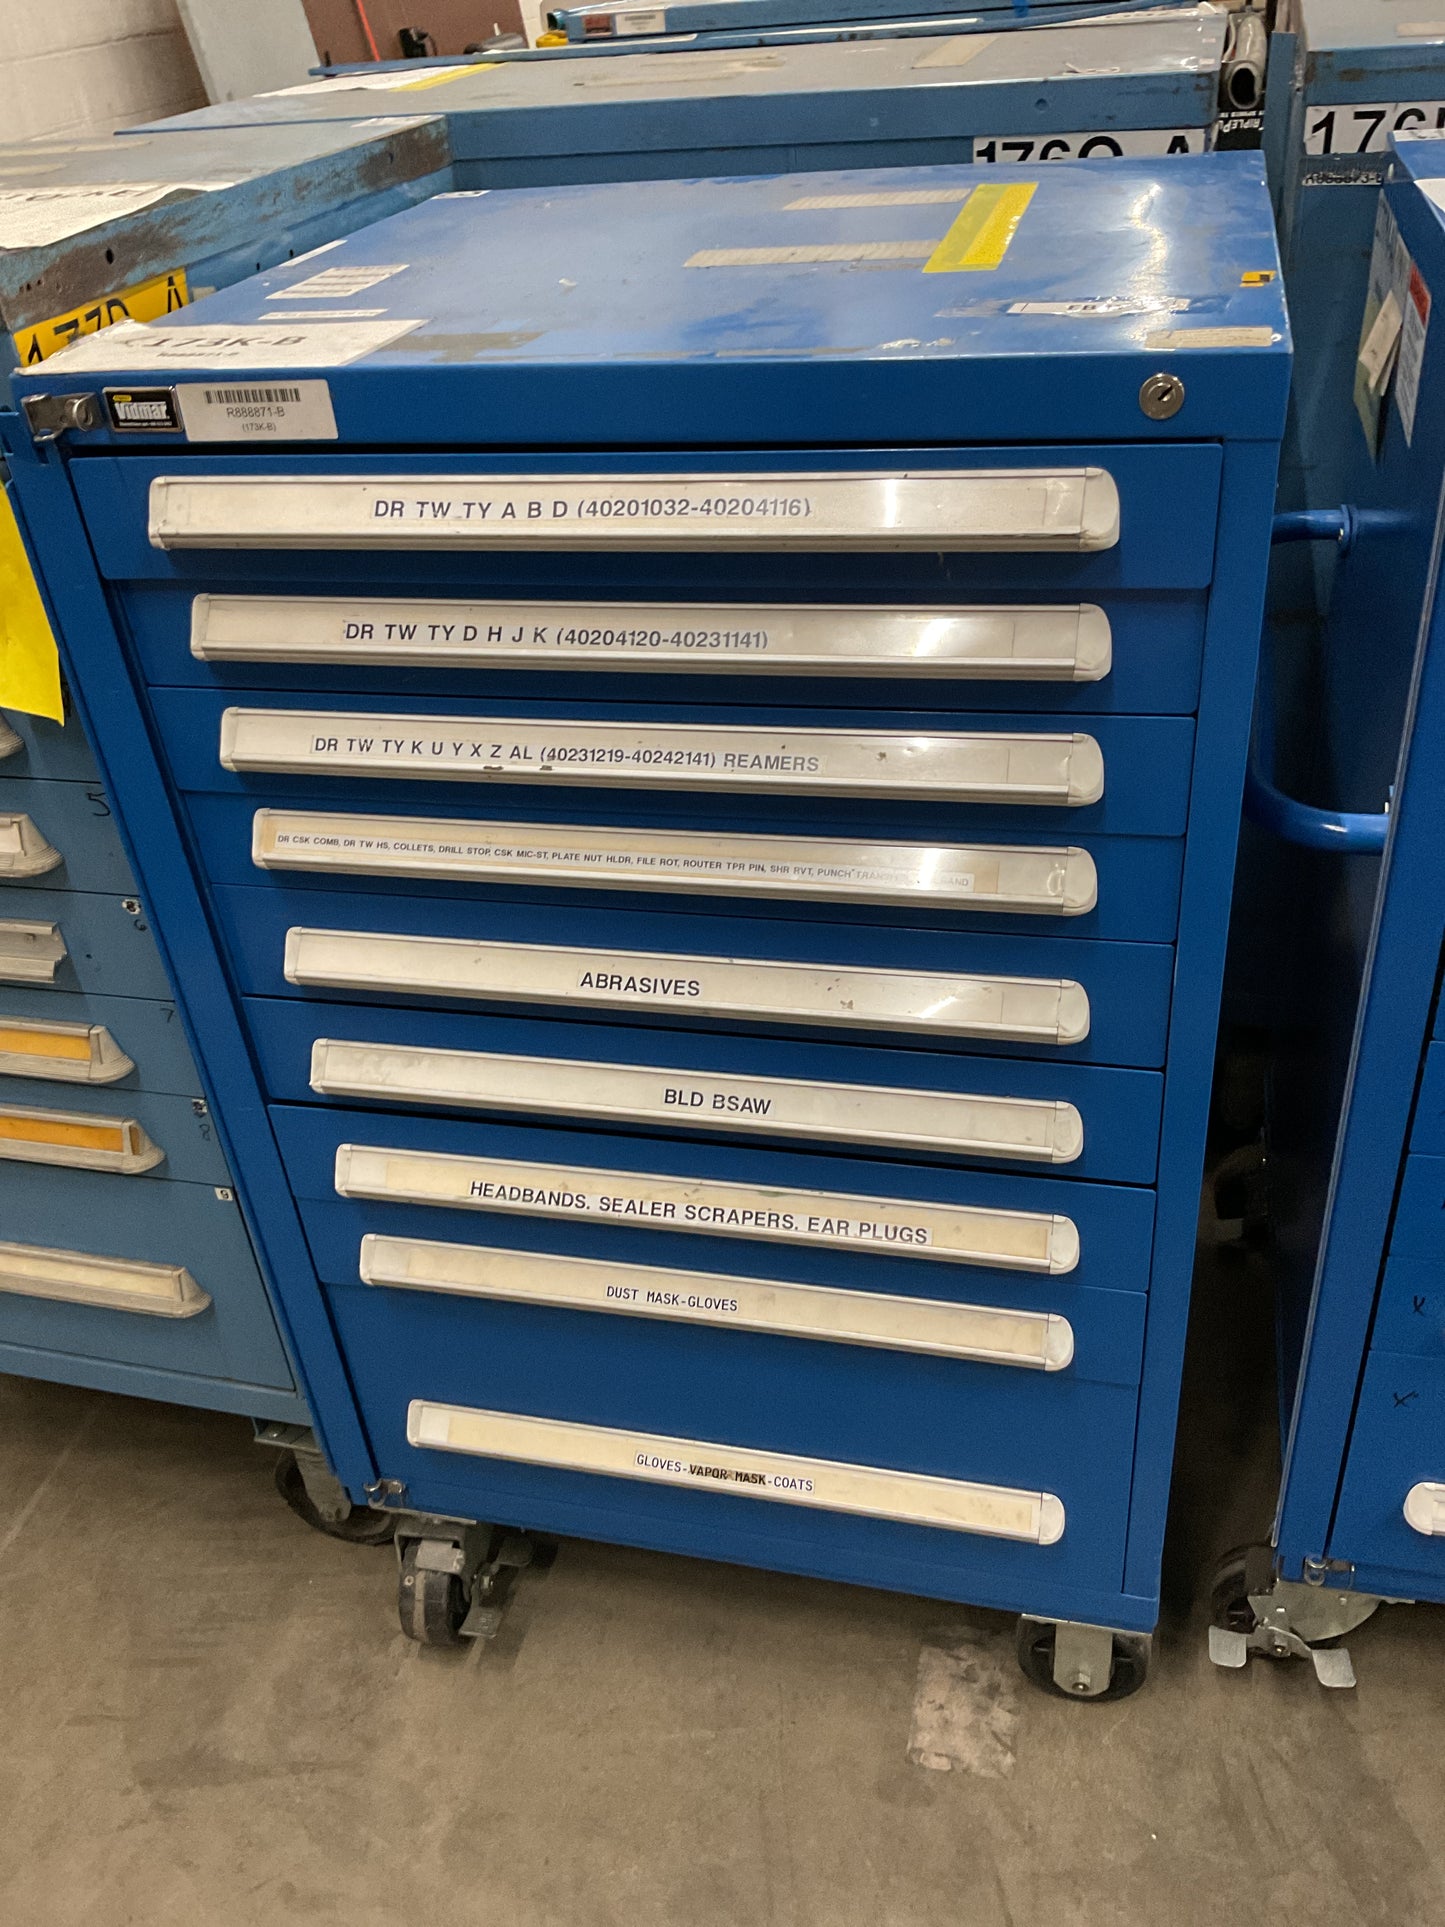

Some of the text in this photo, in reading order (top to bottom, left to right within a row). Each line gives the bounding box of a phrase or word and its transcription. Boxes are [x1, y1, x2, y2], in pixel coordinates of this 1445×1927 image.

[1311, 107, 1445, 154] 176
[114, 401, 168, 420] Vidmar
[226, 406, 285, 418] R888871-B
[242, 423, 277, 433] (173K-B)
[374, 498, 811, 519] DR TW TY A B D (40201032-40204116)
[346, 623, 768, 649] DR TW TY D H J K (40204120-40231141)
[315, 737, 820, 772] DR TW TY K U Y X Z AL (40231219-40242141) REAMERS
[277, 835, 289, 843] DR
[292, 836, 310, 845] CSK
[313, 837, 341, 847] COMB,
[343, 839, 356, 847] DR
[360, 840, 374, 848] TW
[376, 841, 391, 851] HS,
[393, 842, 436, 854] COLLETS,
[438, 845, 463, 854] DRILL
[494, 849, 513, 857] CSK
[516, 850, 549, 860] MIC-ST,
[551, 852, 581, 861] PLATE
[583, 853, 602, 862] NUT
[606, 855, 633, 866] HLDR,
[636, 856, 656, 866] FILE
[659, 858, 681, 868] ROT,
[683, 859, 722, 869] ROUTER
[726, 862, 745, 871] TPR
[748, 863, 767, 873] PIN,
[770, 864, 790, 874] SHR
[793, 866, 814, 876] RVT,
[817, 868, 851, 878] PUNCH
[580, 972, 700, 996] ABRASIVES
[664, 1089, 771, 1115] BLD BSAW
[599, 1196, 676, 1218] SEALER
[807, 1217, 850, 1236] EAR
[859, 1222, 928, 1244] PLUGS
[606, 1286, 738, 1312] DUST MASK-GLOVES
